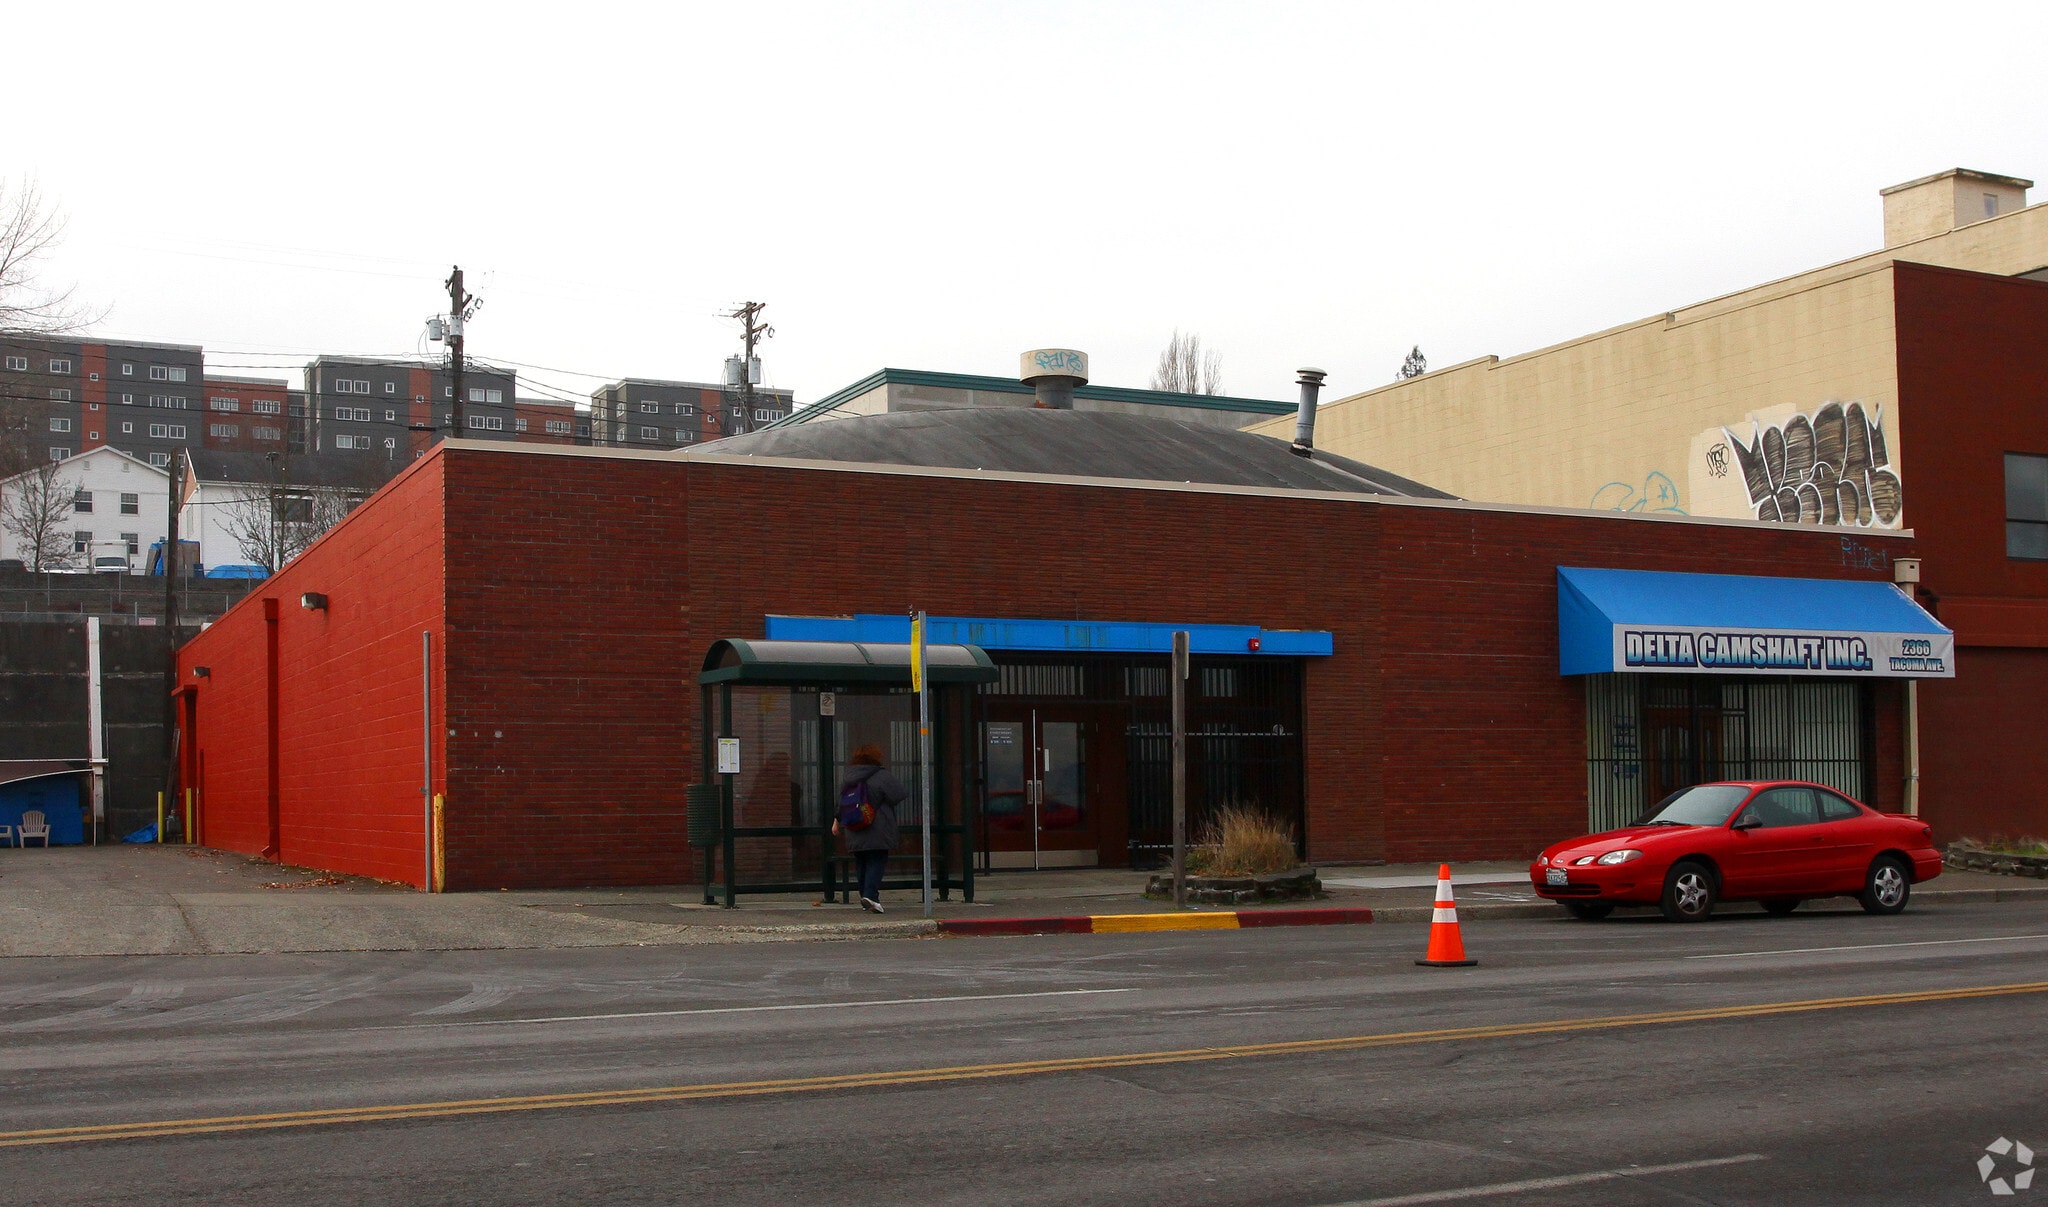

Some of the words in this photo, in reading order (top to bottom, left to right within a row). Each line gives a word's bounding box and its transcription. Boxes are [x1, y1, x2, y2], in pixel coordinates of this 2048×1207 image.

[1625, 631, 1698, 667] DELTA
[1698, 632, 1823, 669] CAMSHAFT
[1825, 637, 1873, 671] INC.
[1903, 639, 1930, 656] 2366
[1889, 657, 1925, 672] TACOMA
[1926, 658, 1944, 672] AVE.
